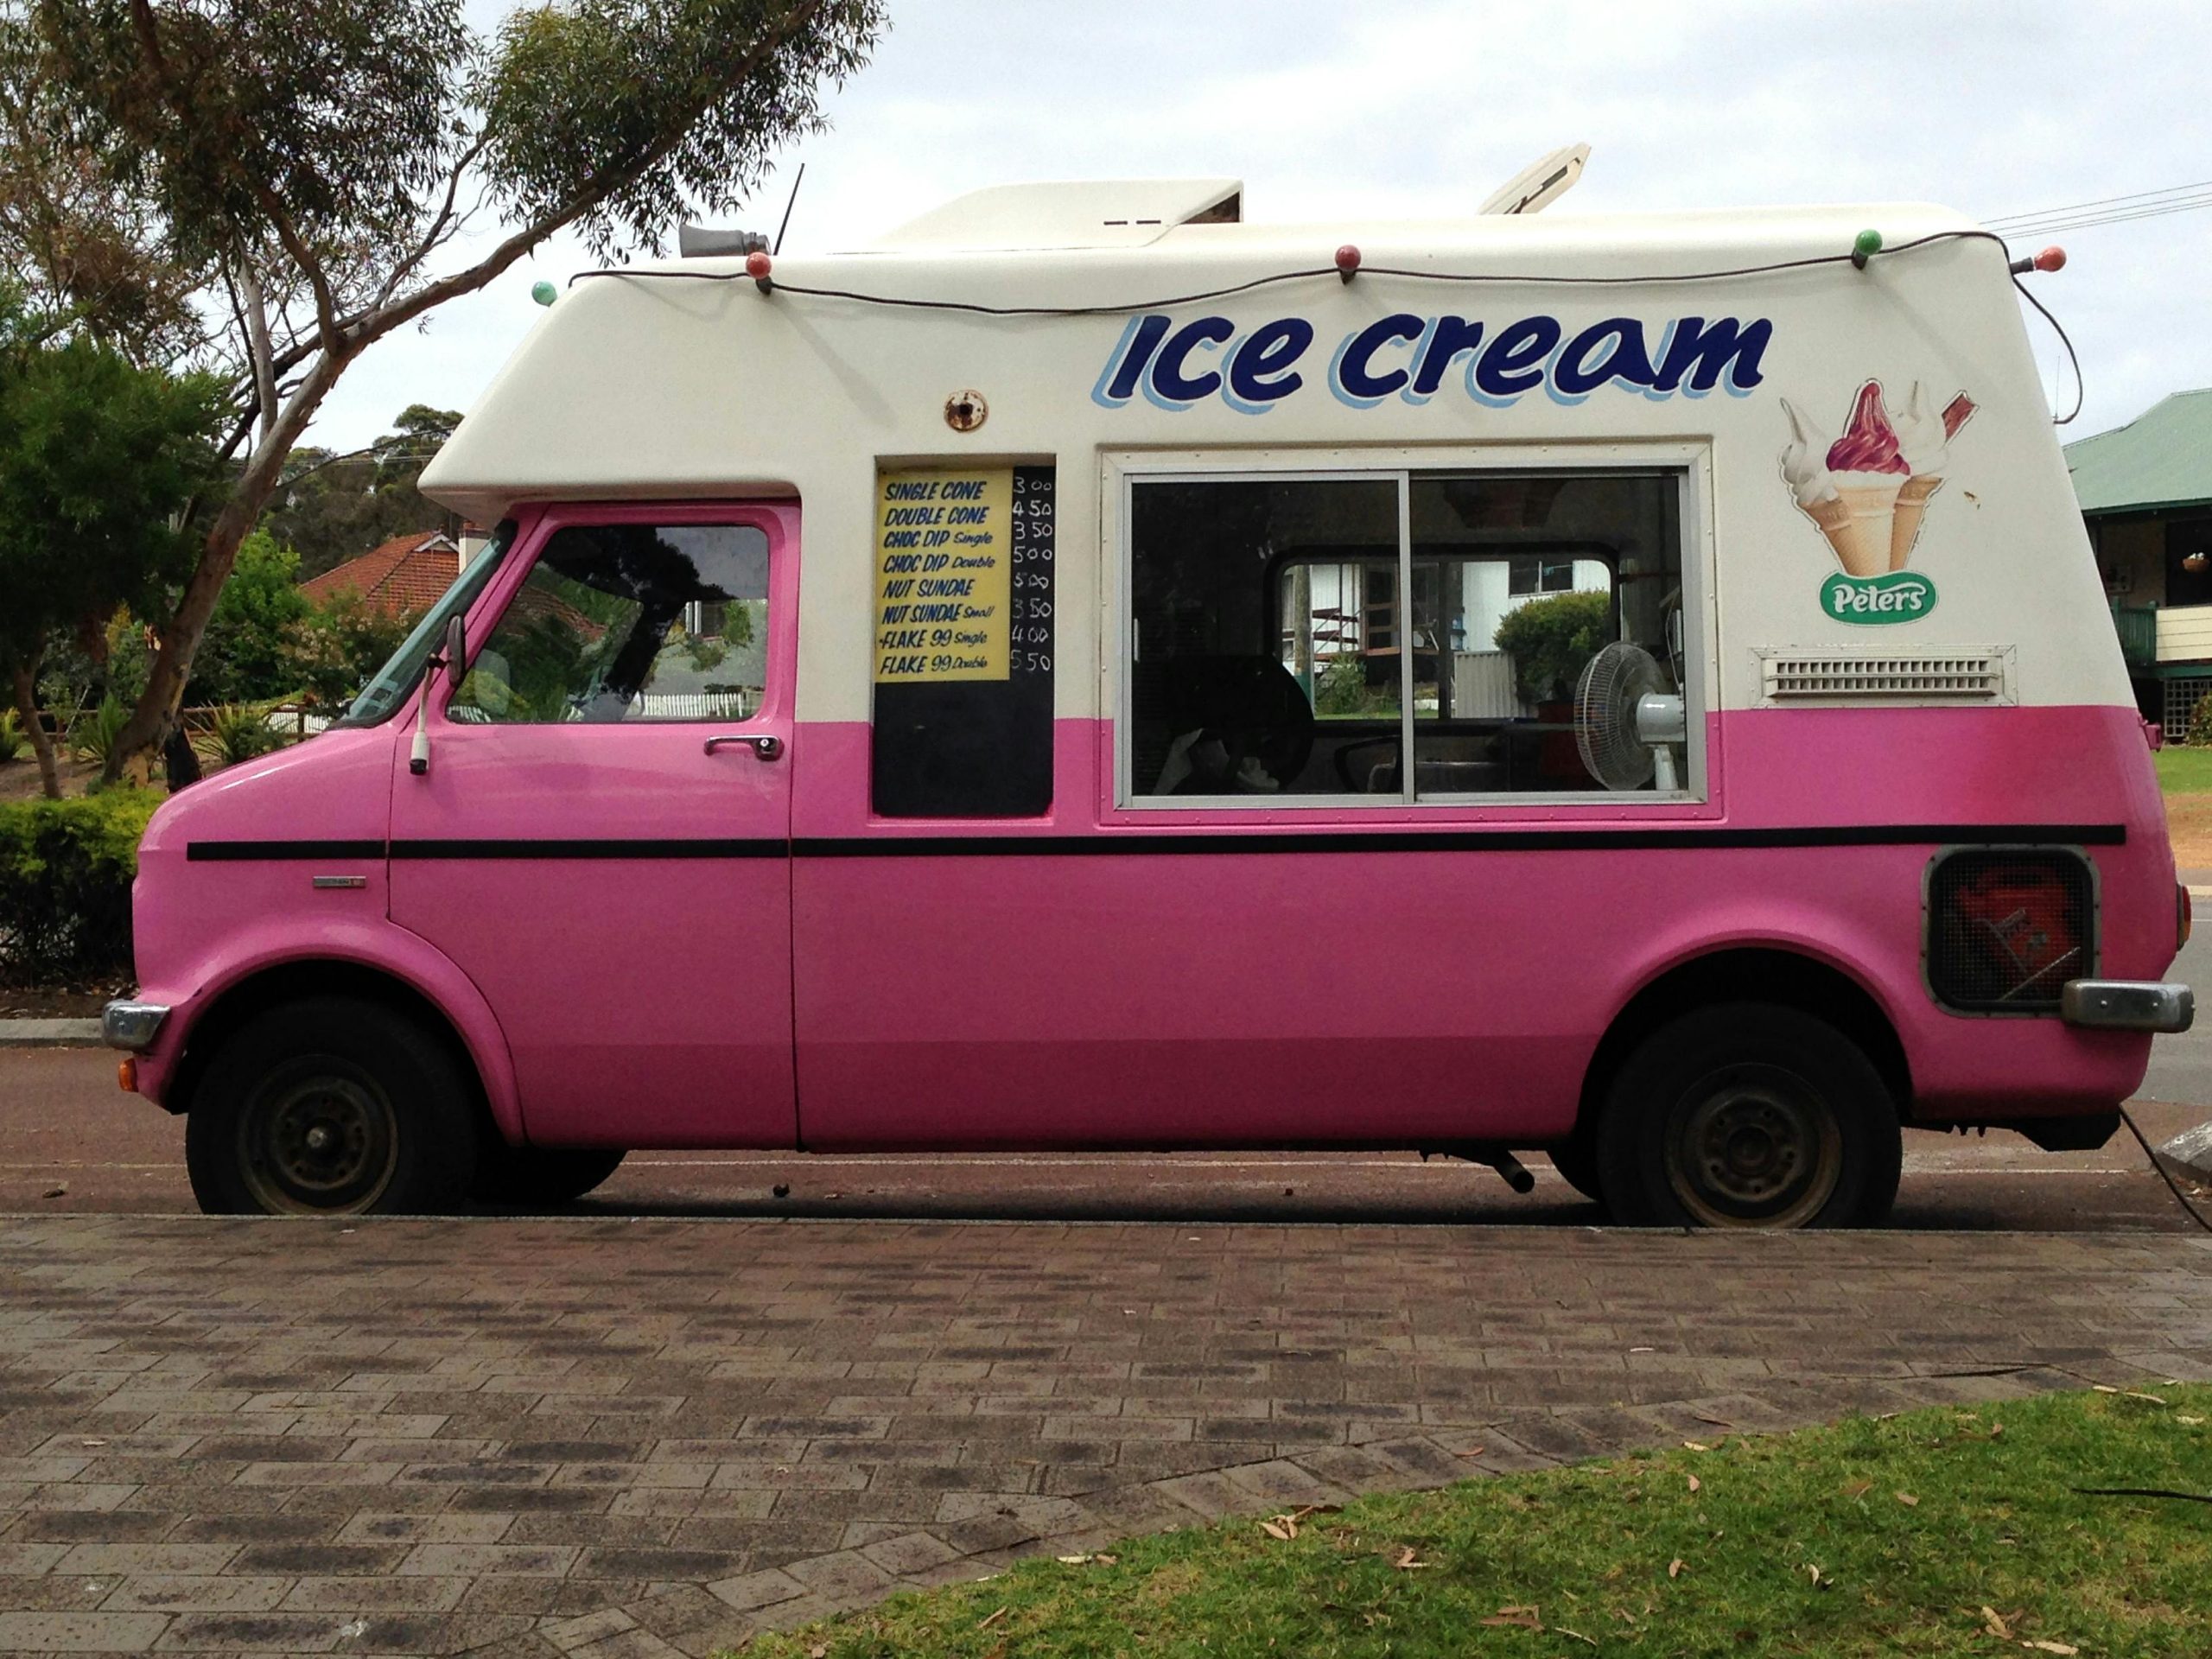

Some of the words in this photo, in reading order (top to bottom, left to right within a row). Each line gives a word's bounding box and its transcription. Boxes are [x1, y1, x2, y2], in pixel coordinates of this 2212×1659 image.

[885, 482, 938, 501] SINGLE
[941, 481, 987, 499] CONE
[1014, 477, 1025, 493] 3
[885, 507, 945, 526] DOUBLE
[948, 507, 989, 524] CONE
[1013, 501, 1023, 516] 4
[1029, 500, 1052, 517] 50
[1014, 523, 1025, 538] 3
[1033, 522, 1052, 537] 50
[884, 531, 921, 548] CHOC
[923, 531, 950, 546] DIP
[953, 532, 993, 547] Single
[884, 556, 921, 573] CHOC
[922, 556, 949, 571] DIP
[951, 556, 995, 569] Double
[882, 581, 915, 598] NUT
[918, 579, 975, 596] SUNDAE
[1832, 582, 1927, 613] Peters
[882, 606, 910, 624] NUT
[910, 604, 963, 622] SUNDAE
[963, 606, 995, 619] Small
[930, 630, 952, 645] 99
[955, 631, 988, 644] Single
[880, 657, 927, 674] FLAKE
[931, 657, 953, 671] 99
[952, 657, 988, 669] Double
[1027, 653, 1052, 671] 50
